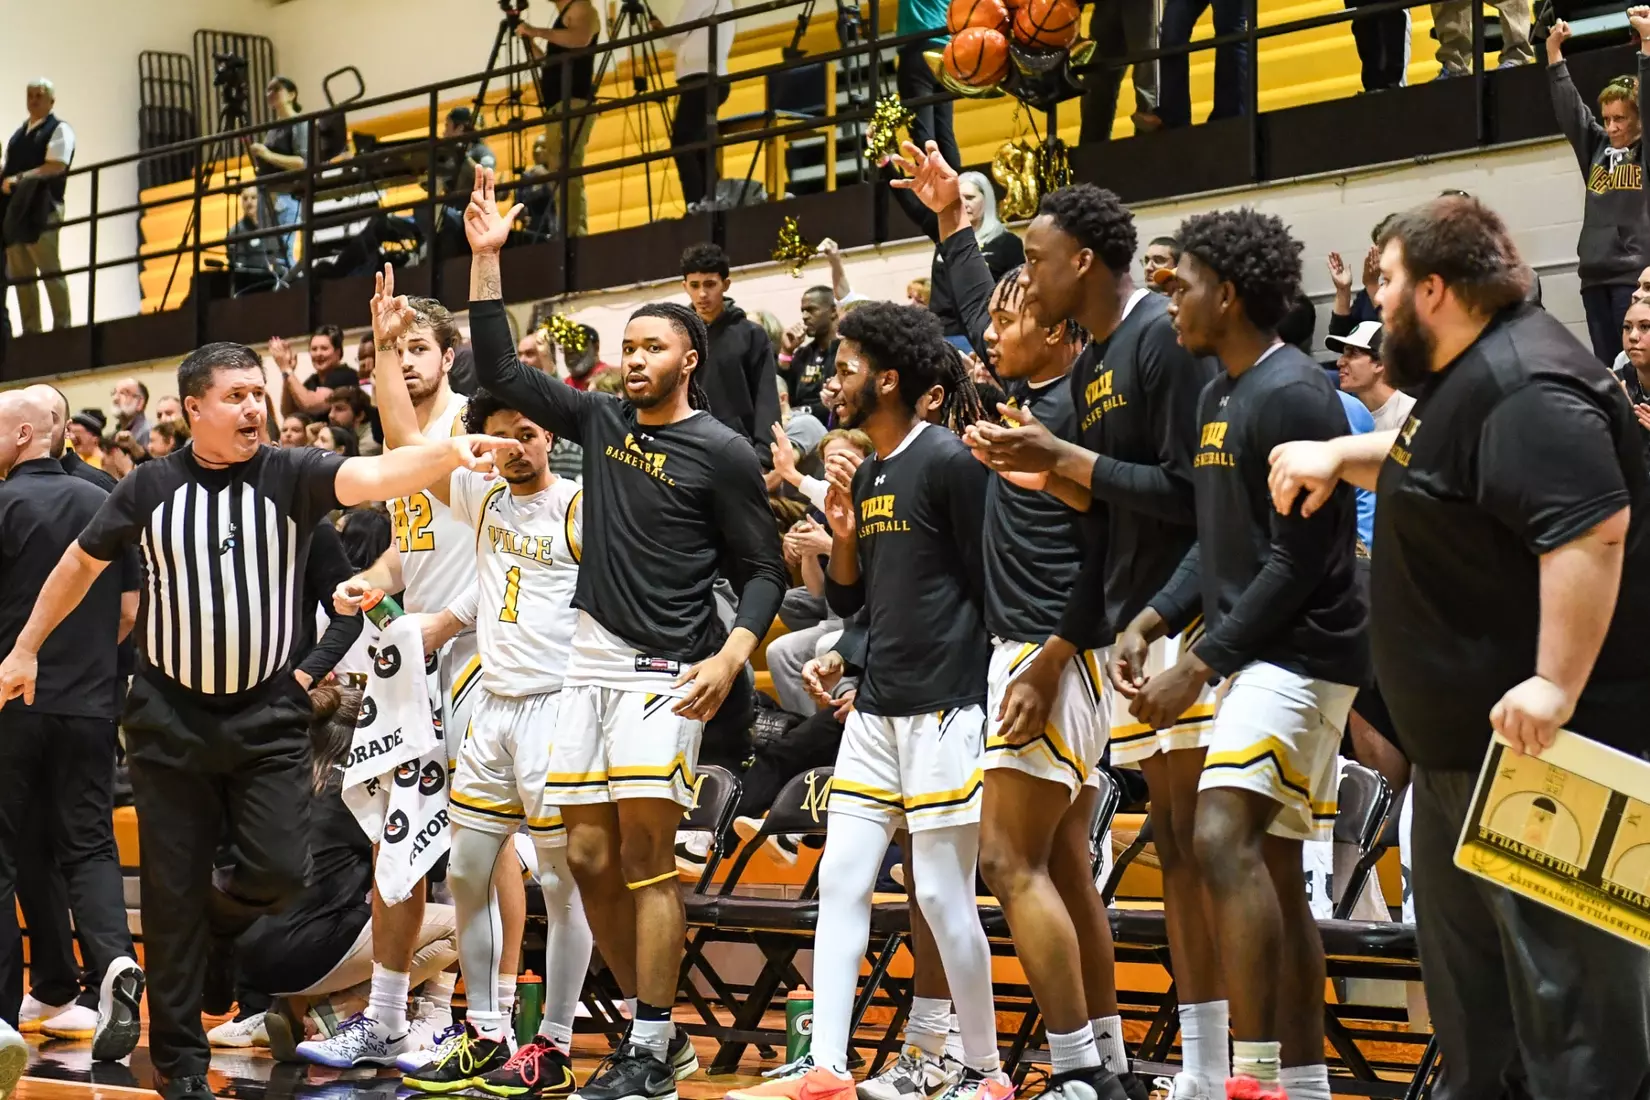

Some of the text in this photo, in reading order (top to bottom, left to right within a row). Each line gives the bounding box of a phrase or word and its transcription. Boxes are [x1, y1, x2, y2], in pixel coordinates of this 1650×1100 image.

[605, 445, 676, 487] BASKETBALL
[394, 491, 435, 553] 42
[861, 494, 895, 522] VILLE
[487, 525, 553, 566] VILLE
[498, 565, 521, 624] 1
[1478, 827, 1581, 878] MILLERSVILLE
